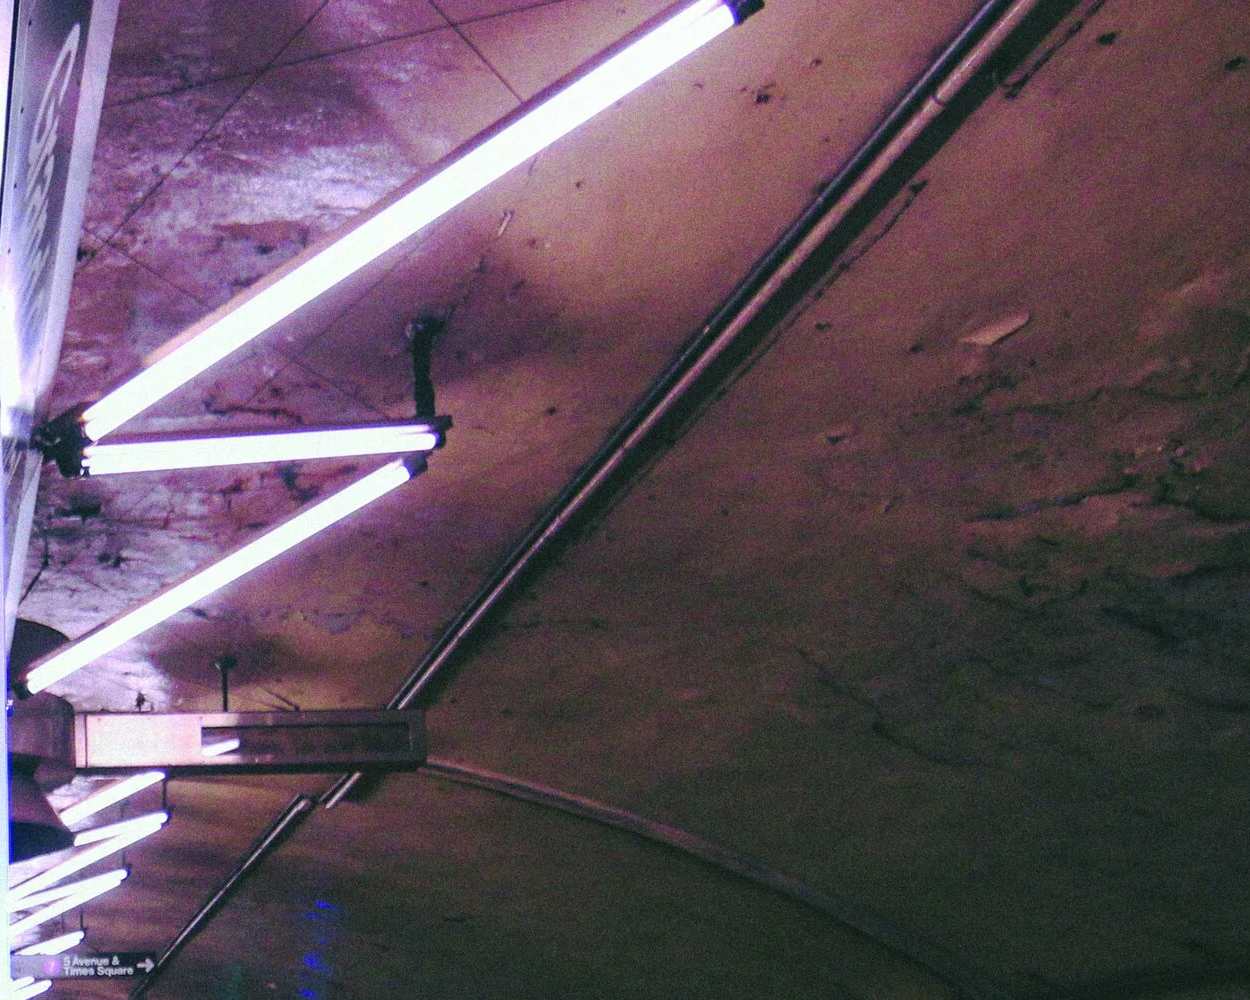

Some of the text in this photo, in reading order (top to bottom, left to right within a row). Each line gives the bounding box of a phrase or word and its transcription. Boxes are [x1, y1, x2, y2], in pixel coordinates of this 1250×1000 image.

[72, 958, 109, 967] Avenue
[112, 956, 119, 965] &
[64, 966, 134, 977] Times Square
